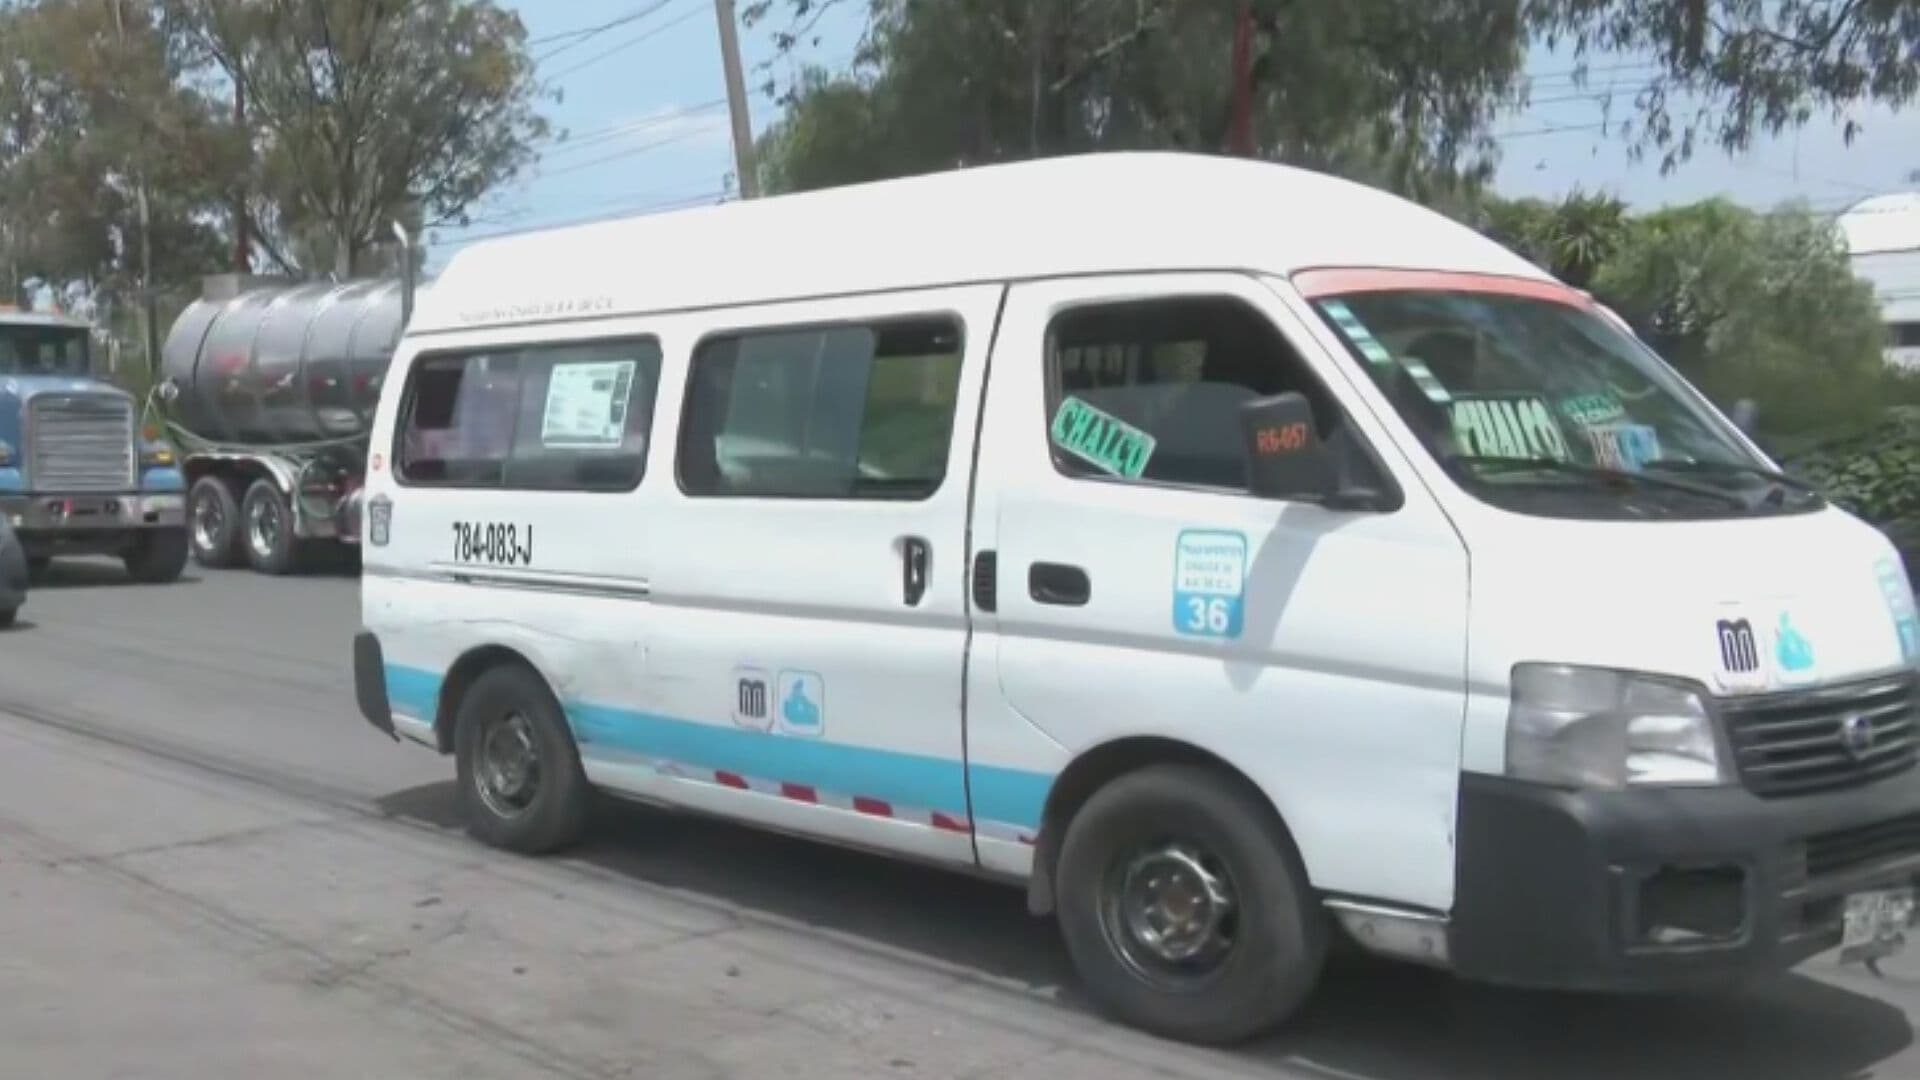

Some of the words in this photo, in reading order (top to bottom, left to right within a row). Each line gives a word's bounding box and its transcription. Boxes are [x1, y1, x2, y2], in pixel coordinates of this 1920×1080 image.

[1060, 403, 1145, 474] CHALCO
[452, 522, 533, 565] 784-083-J
[1187, 595, 1229, 634] 36
